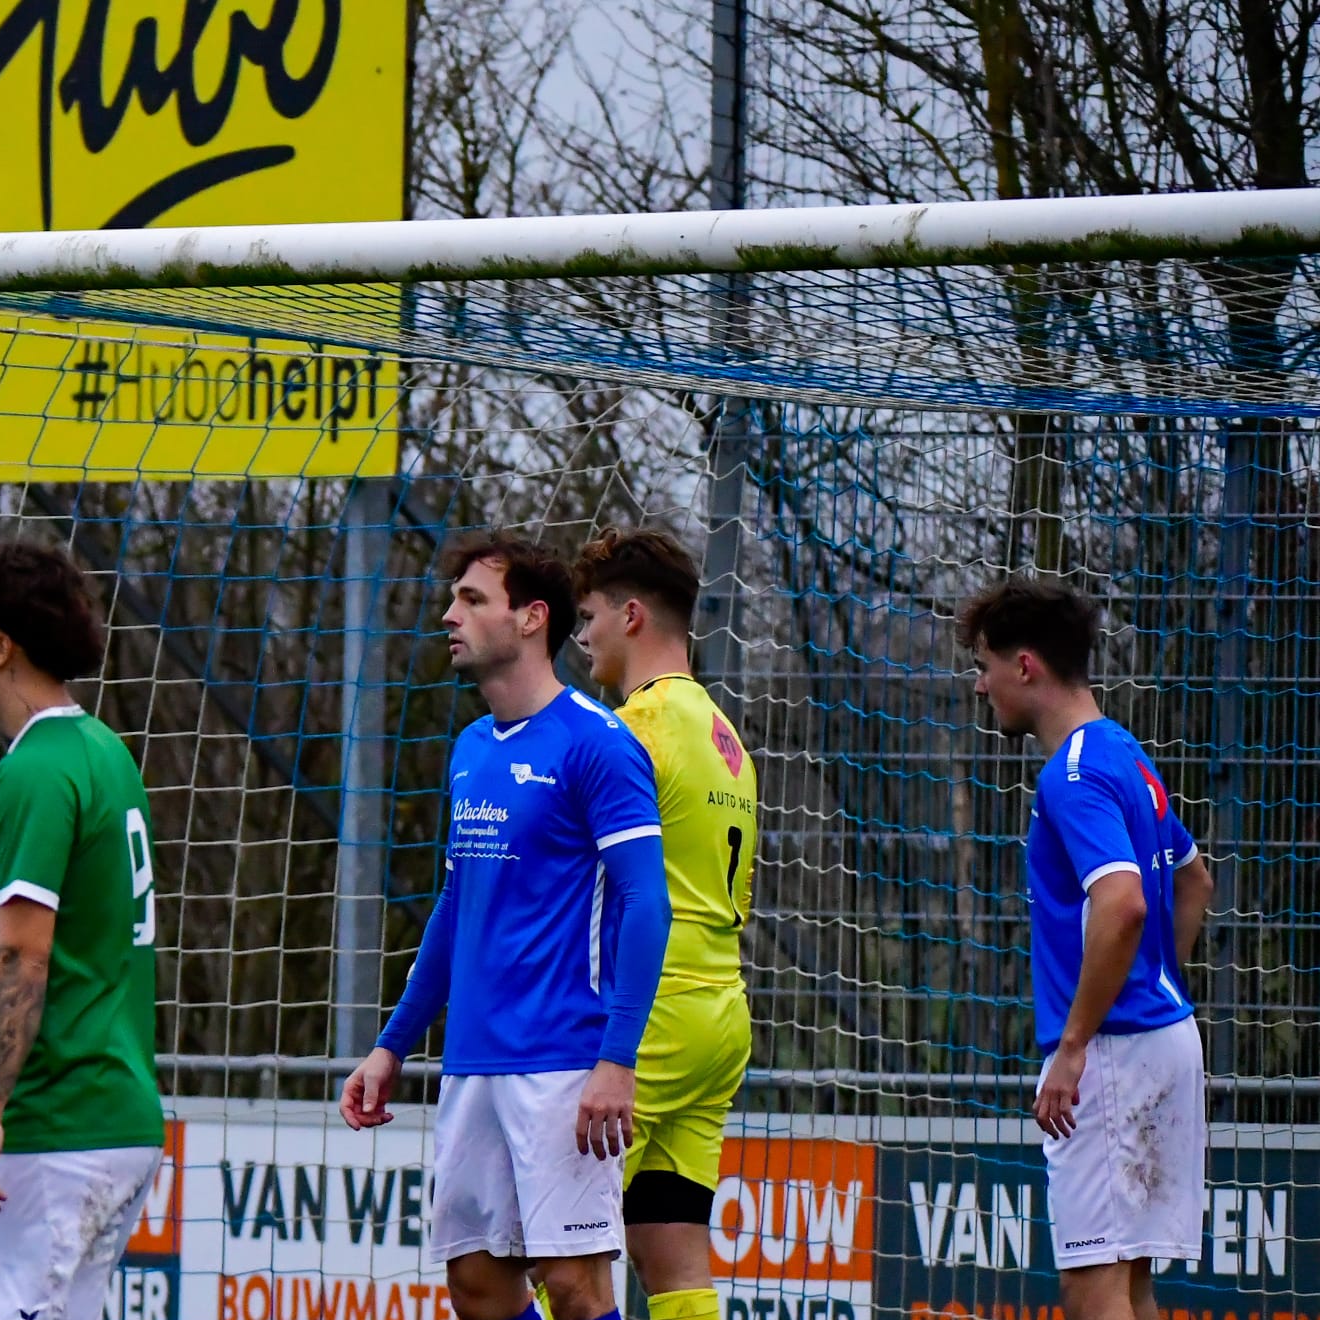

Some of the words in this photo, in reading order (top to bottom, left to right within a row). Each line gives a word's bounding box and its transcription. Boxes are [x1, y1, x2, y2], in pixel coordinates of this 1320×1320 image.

[454, 798, 509, 822] Wachters
[707, 790, 736, 809] AUTO
[738, 796, 752, 814] ME
[220, 1160, 327, 1244] VAN
[342, 1165, 434, 1248] WE
[563, 1221, 609, 1232] STANNO
[909, 1181, 1032, 1270] VAN
